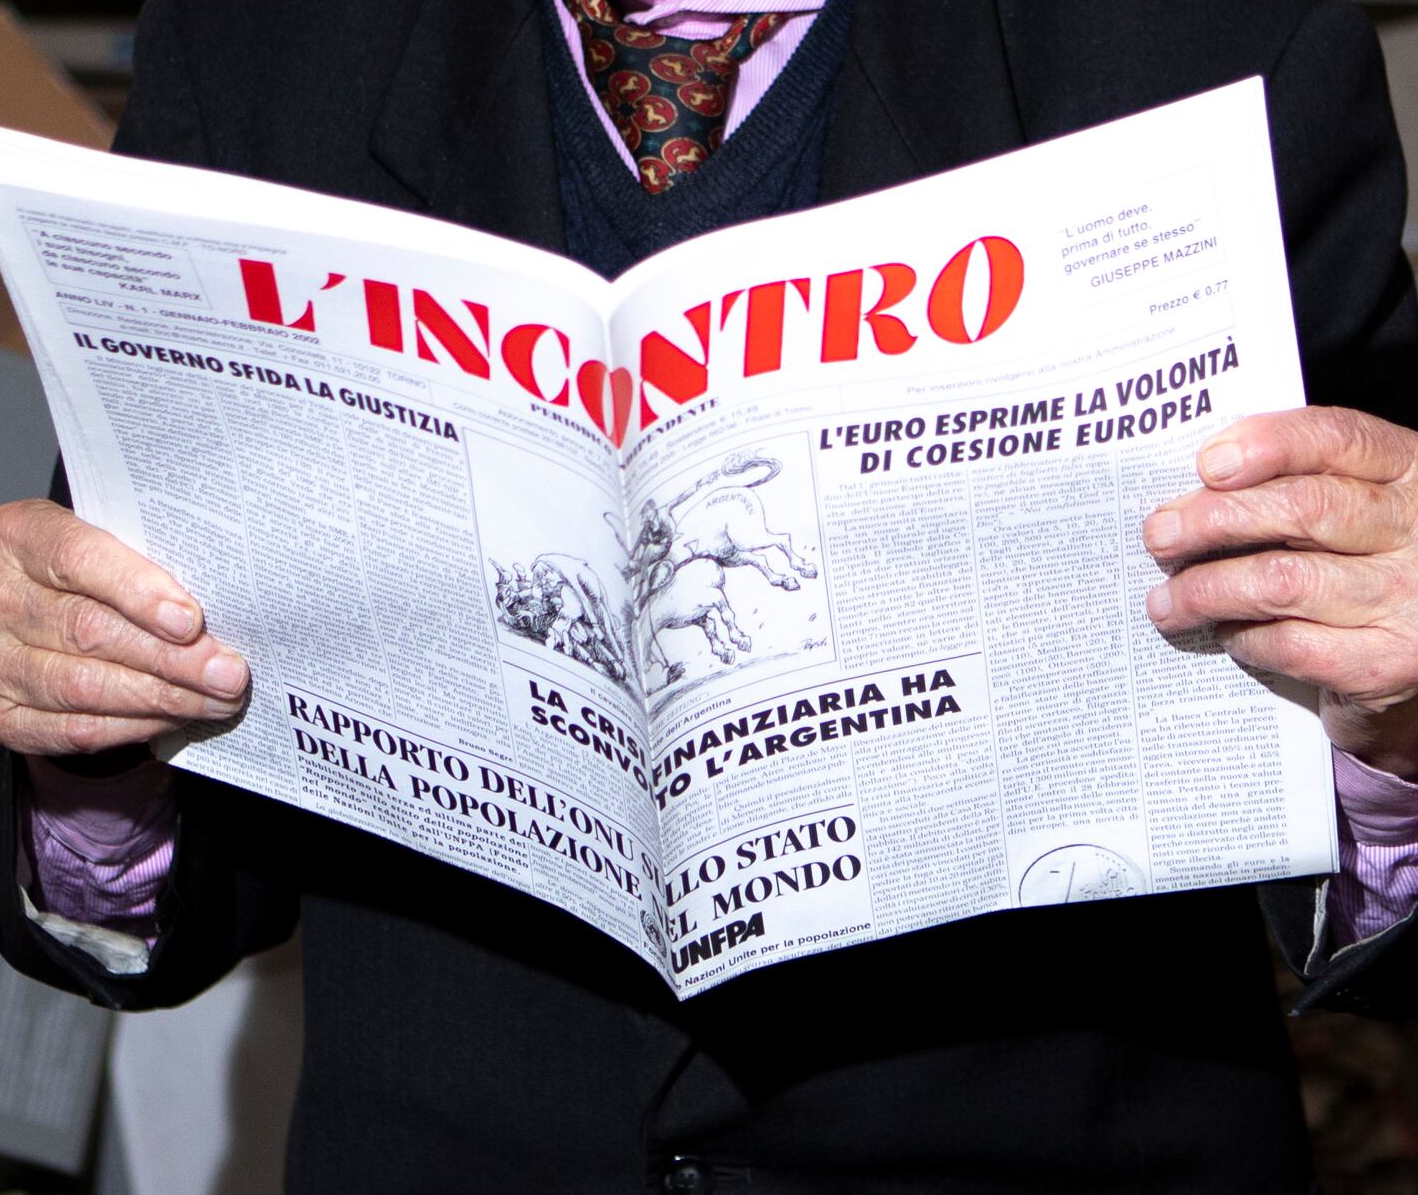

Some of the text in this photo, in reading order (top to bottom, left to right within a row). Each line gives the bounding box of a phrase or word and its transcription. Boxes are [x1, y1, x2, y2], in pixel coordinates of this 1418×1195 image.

[52, 234, 112, 250] ciascuno
[115, 243, 173, 260] secondo
[1061, 239, 1098, 259] prima
[1102, 231, 1114, 244] di
[1064, 244, 1129, 276] governare
[1134, 238, 1148, 251] se
[1090, 236, 1218, 288] GIUSEPPE MAZZINI
[42, 250, 182, 280] da ciascuno secondo
[45, 259, 59, 267] le
[59, 262, 84, 273] sue
[118, 282, 203, 302] KARL MARX
[1149, 295, 1189, 316] Prezzo
[1193, 289, 1201, 300] €
[55, 291, 93, 305] ANNO
[93, 299, 114, 308] LIV
[291, 332, 322, 346] 2002
[1038, 363, 1057, 374] alla
[1059, 354, 1093, 371] nostra
[1095, 325, 1177, 359] Amministrazione
[73, 332, 99, 350] IL
[100, 336, 225, 375] GOVERNO
[228, 360, 302, 392] SFIDA
[304, 377, 336, 402] LA
[339, 387, 460, 442] GIUSTIZIA
[387, 370, 427, 389] TORINO
[819, 335, 1240, 452] L'EURO ESPRIME LA VOLONTÀ
[619, 396, 721, 470] NDIPENDENTE
[860, 388, 1214, 476] DI COESIONE EUROPEA
[529, 679, 569, 714] LA
[580, 706, 647, 769] CRISI
[652, 683, 886, 788] FINANZIARIA
[901, 669, 957, 697] HA
[665, 698, 732, 737] dell'Argentina
[1140, 727, 1156, 735] pea
[1159, 724, 1171, 733] ha
[1174, 720, 1211, 731] rilevato
[1212, 717, 1229, 726] che
[1141, 724, 1279, 743] tuale di accettazione dell'euro
[1171, 713, 1201, 722] Banca
[1204, 707, 1245, 718] Centrale
[458, 738, 488, 753] Bruno
[706, 694, 963, 779] L'ARGENTINA
[1142, 744, 1166, 752] nelle
[1168, 738, 1222, 749] transazioni
[1224, 733, 1268, 743] ordinarie
[1143, 752, 1173, 762] aggira
[1175, 748, 1210, 759] intorno
[1244, 743, 1254, 751] in
[1256, 742, 1280, 750] tutta
[286, 691, 471, 784] RAPPORTO
[478, 765, 634, 862] DELL'ONU
[736, 815, 857, 871] STATO
[1144, 770, 1159, 779] del
[1160, 767, 1202, 777] contante
[1203, 763, 1249, 773] nazionale
[1257, 760, 1282, 768] stato
[1145, 777, 1190, 788] trasferito
[1193, 774, 1217, 783] nella
[1251, 768, 1282, 778] valuta
[298, 754, 527, 849] Pubblichiamo la terza ed ultima parte del
[301, 775, 319, 787] nel
[372, 804, 413, 826] redatto
[418, 823, 483, 851] dall'UNFPA
[302, 785, 329, 800] delle
[333, 795, 375, 818] Nazioni
[379, 815, 408, 833] Unite
[411, 830, 430, 843] per
[433, 837, 444, 846] la
[1191, 802, 1206, 811] del
[1208, 800, 1242, 809] denaro
[1243, 797, 1285, 806] contante
[292, 726, 399, 792] DELLA
[408, 773, 643, 902] POPOLAZIONE
[711, 854, 863, 921] MONDO
[360, 788, 387, 806] sullo
[391, 801, 421, 820] stato
[423, 813, 453, 831] della
[457, 828, 529, 859] popolazione
[671, 911, 766, 975] UNFPA
[685, 964, 726, 987] Nazioni
[728, 948, 758, 967] Unite
[761, 943, 780, 957] per
[783, 939, 793, 948] la
[798, 922, 871, 946] popolazione
